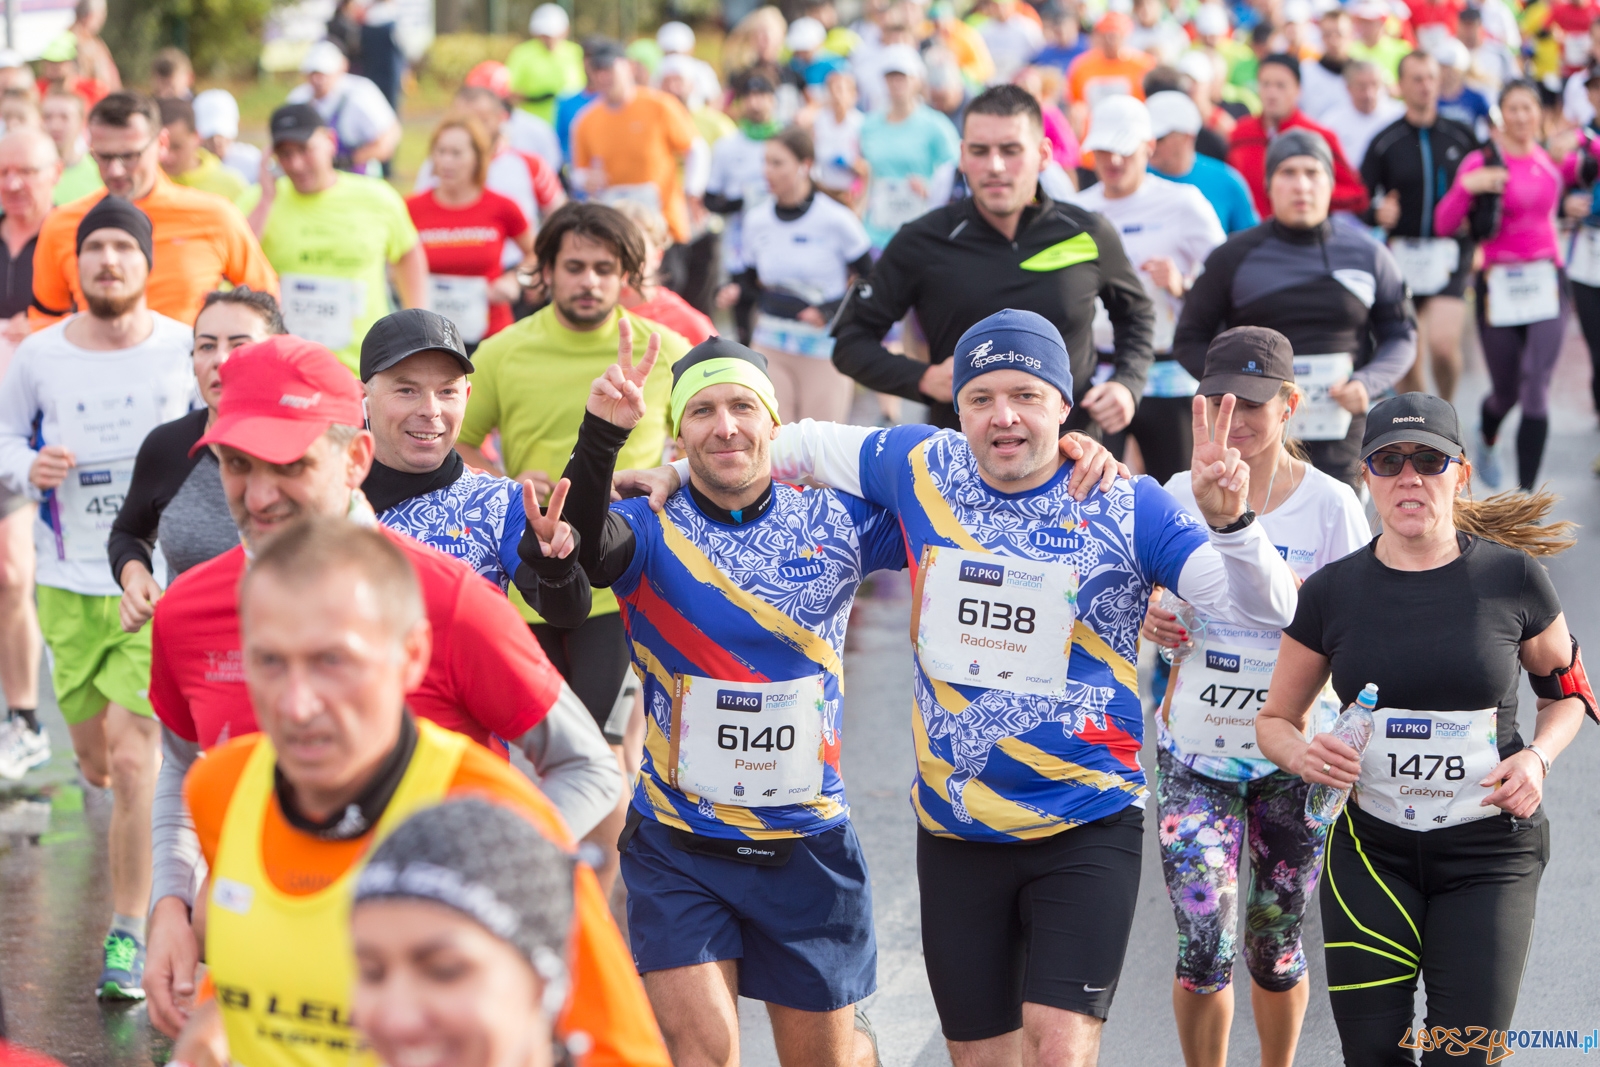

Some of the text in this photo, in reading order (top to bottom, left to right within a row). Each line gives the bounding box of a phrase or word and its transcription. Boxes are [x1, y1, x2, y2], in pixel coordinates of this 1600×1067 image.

[975, 351, 1041, 369] speedjogg
[1392, 416, 1425, 424] Reebok
[86, 494, 125, 515] 45
[1035, 532, 1079, 549] Duni
[781, 560, 821, 578] Duni
[964, 566, 1000, 580] 17. PKO
[1006, 578, 1042, 588] maraton
[958, 598, 1036, 634] 6138
[1261, 631, 1281, 639] 2016
[960, 633, 1027, 653] Radosław
[1220, 657, 1237, 668] PKO
[997, 671, 1014, 679] 4F
[721, 695, 758, 707] 17. PKO
[765, 699, 797, 709] maraton
[1391, 724, 1428, 734] 17. PKO
[718, 724, 795, 752] 6140
[735, 759, 777, 771] Paweł
[1387, 753, 1465, 781] 1478
[762, 788, 778, 797] 4F
[1400, 785, 1454, 798] Grażyna
